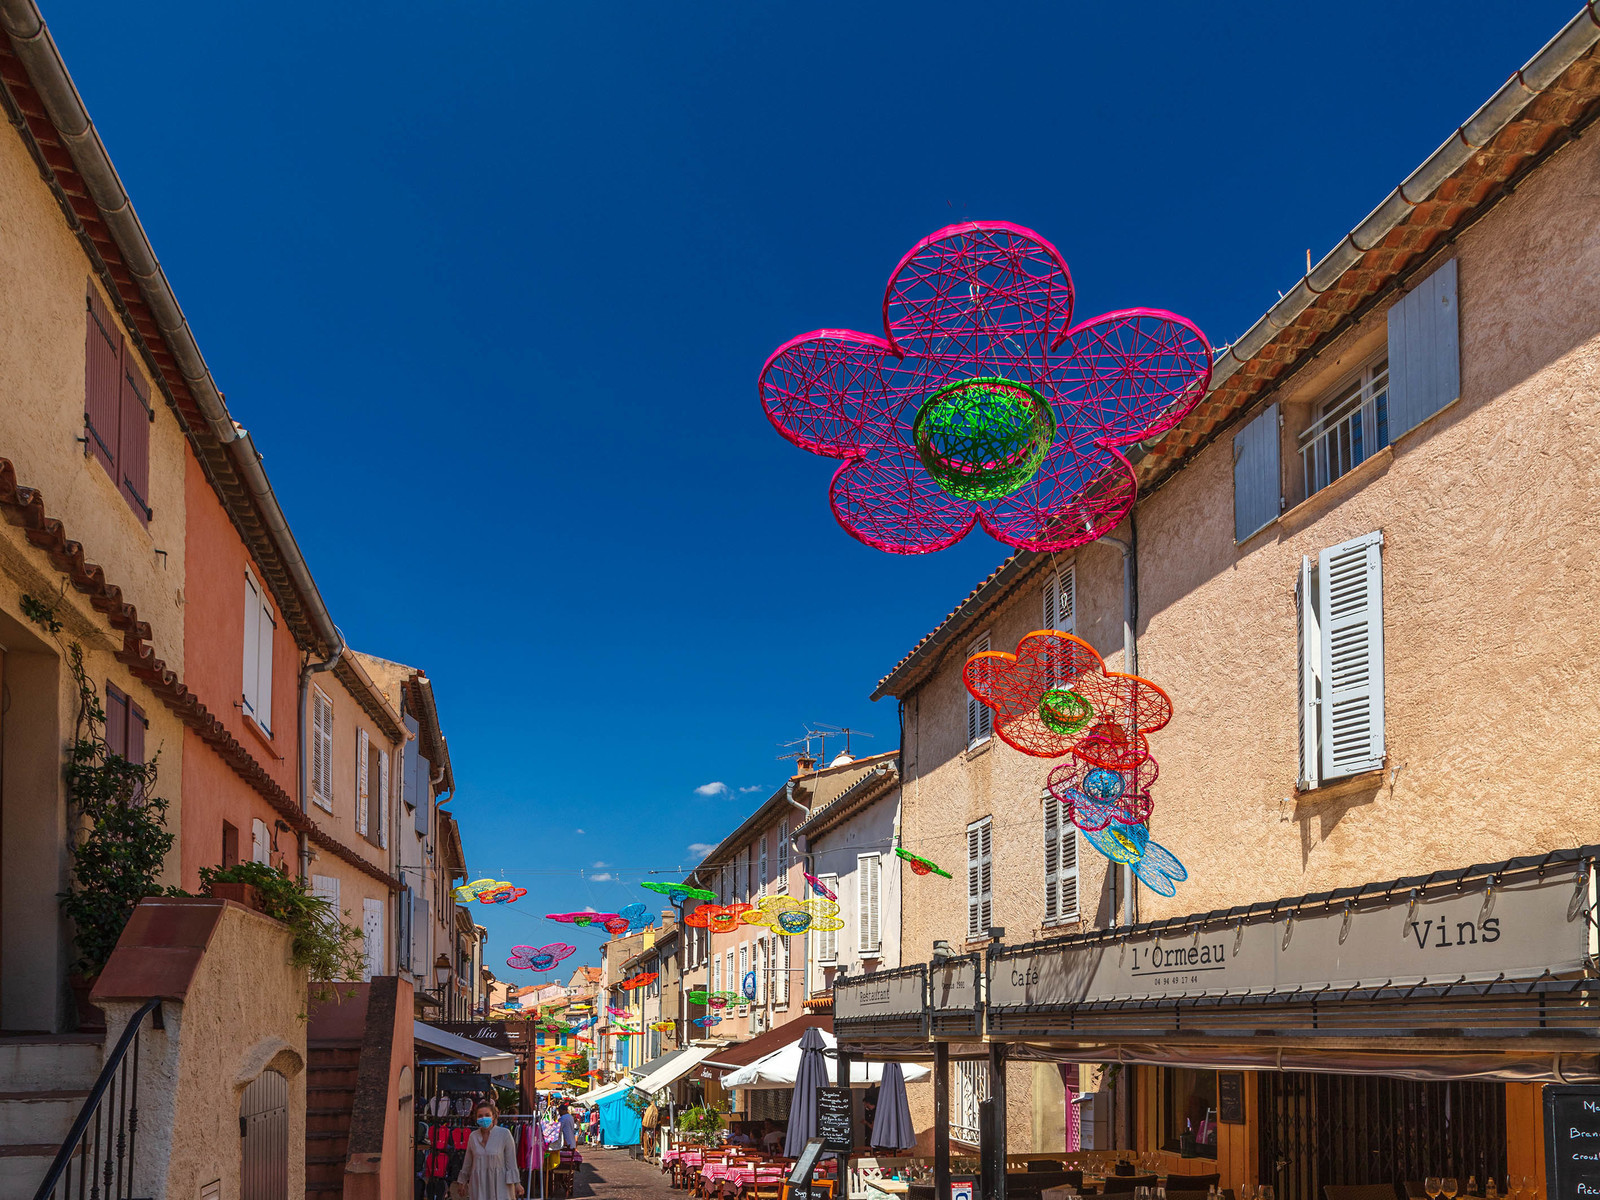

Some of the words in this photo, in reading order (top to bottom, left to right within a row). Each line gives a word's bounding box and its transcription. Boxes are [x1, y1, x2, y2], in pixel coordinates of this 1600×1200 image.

[1410, 915, 1501, 950] Vins
[1131, 943, 1226, 971] l'Ormeau
[1010, 968, 1040, 987] Café
[859, 989, 890, 1002] Restaurant
[469, 1026, 498, 1039] Mia
[1569, 1127, 1600, 1139] Bran
[1577, 1182, 1600, 1195] Pièc
